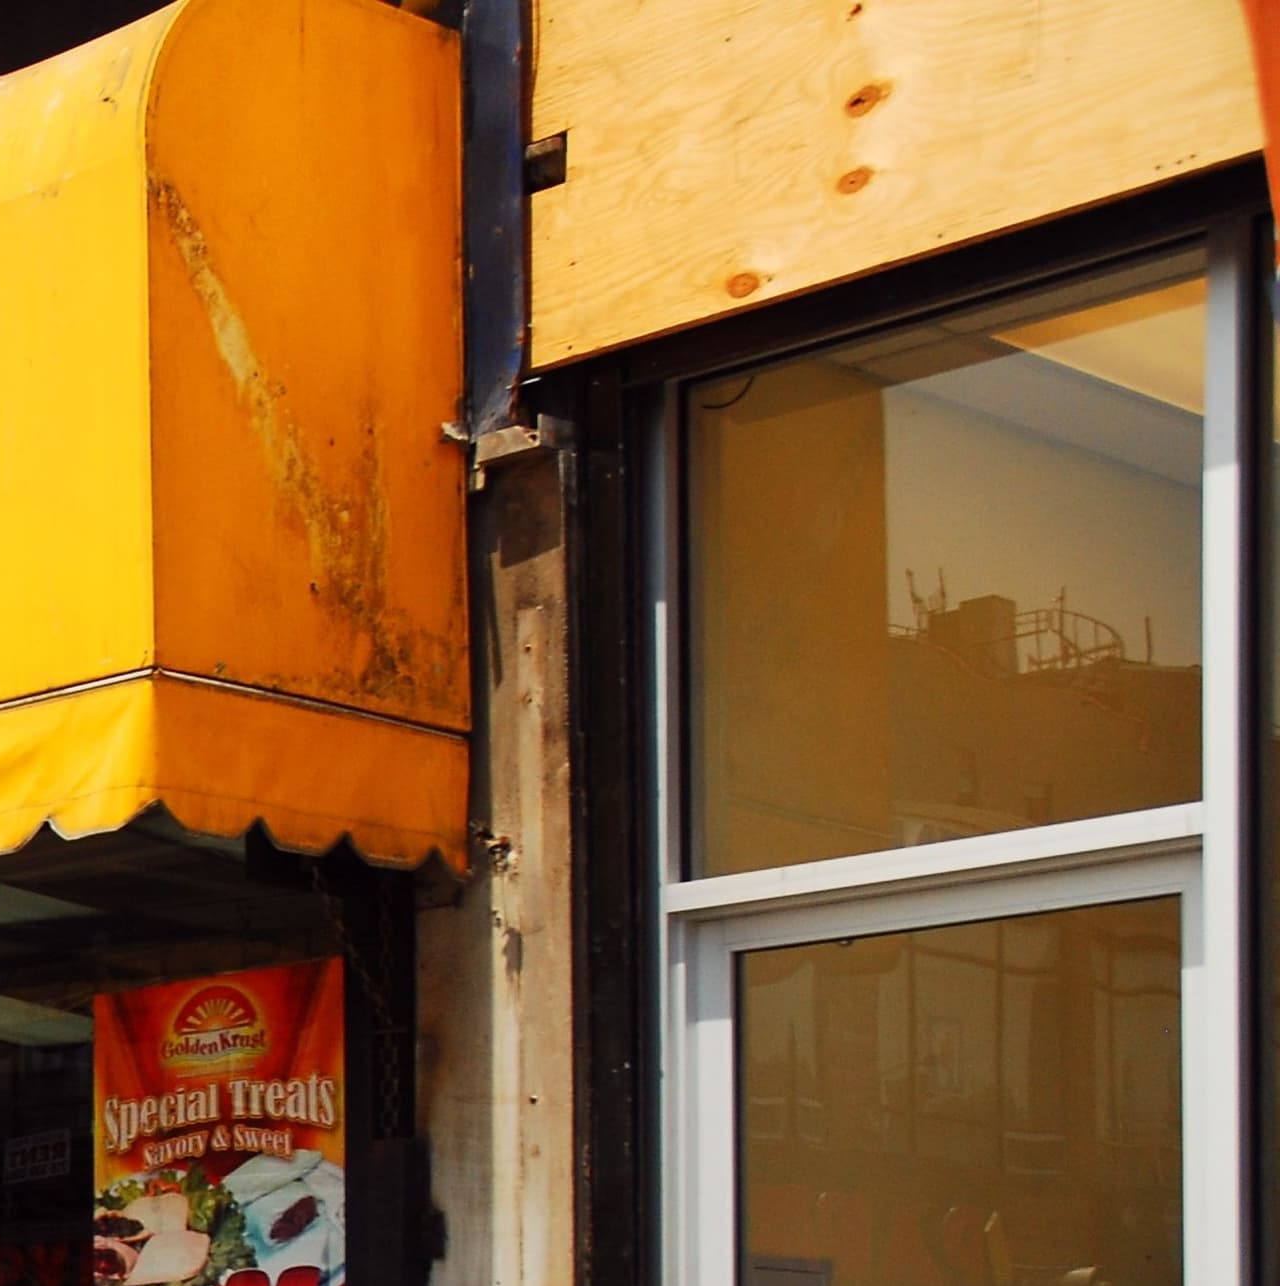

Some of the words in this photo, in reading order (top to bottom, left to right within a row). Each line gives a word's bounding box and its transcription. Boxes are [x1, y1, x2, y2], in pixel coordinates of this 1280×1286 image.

[104, 1083, 219, 1152] Special
[229, 1072, 336, 1128] Treats
[144, 1131, 209, 1169] Savory
[211, 1125, 231, 1150] &
[232, 1123, 292, 1157] Sweet
